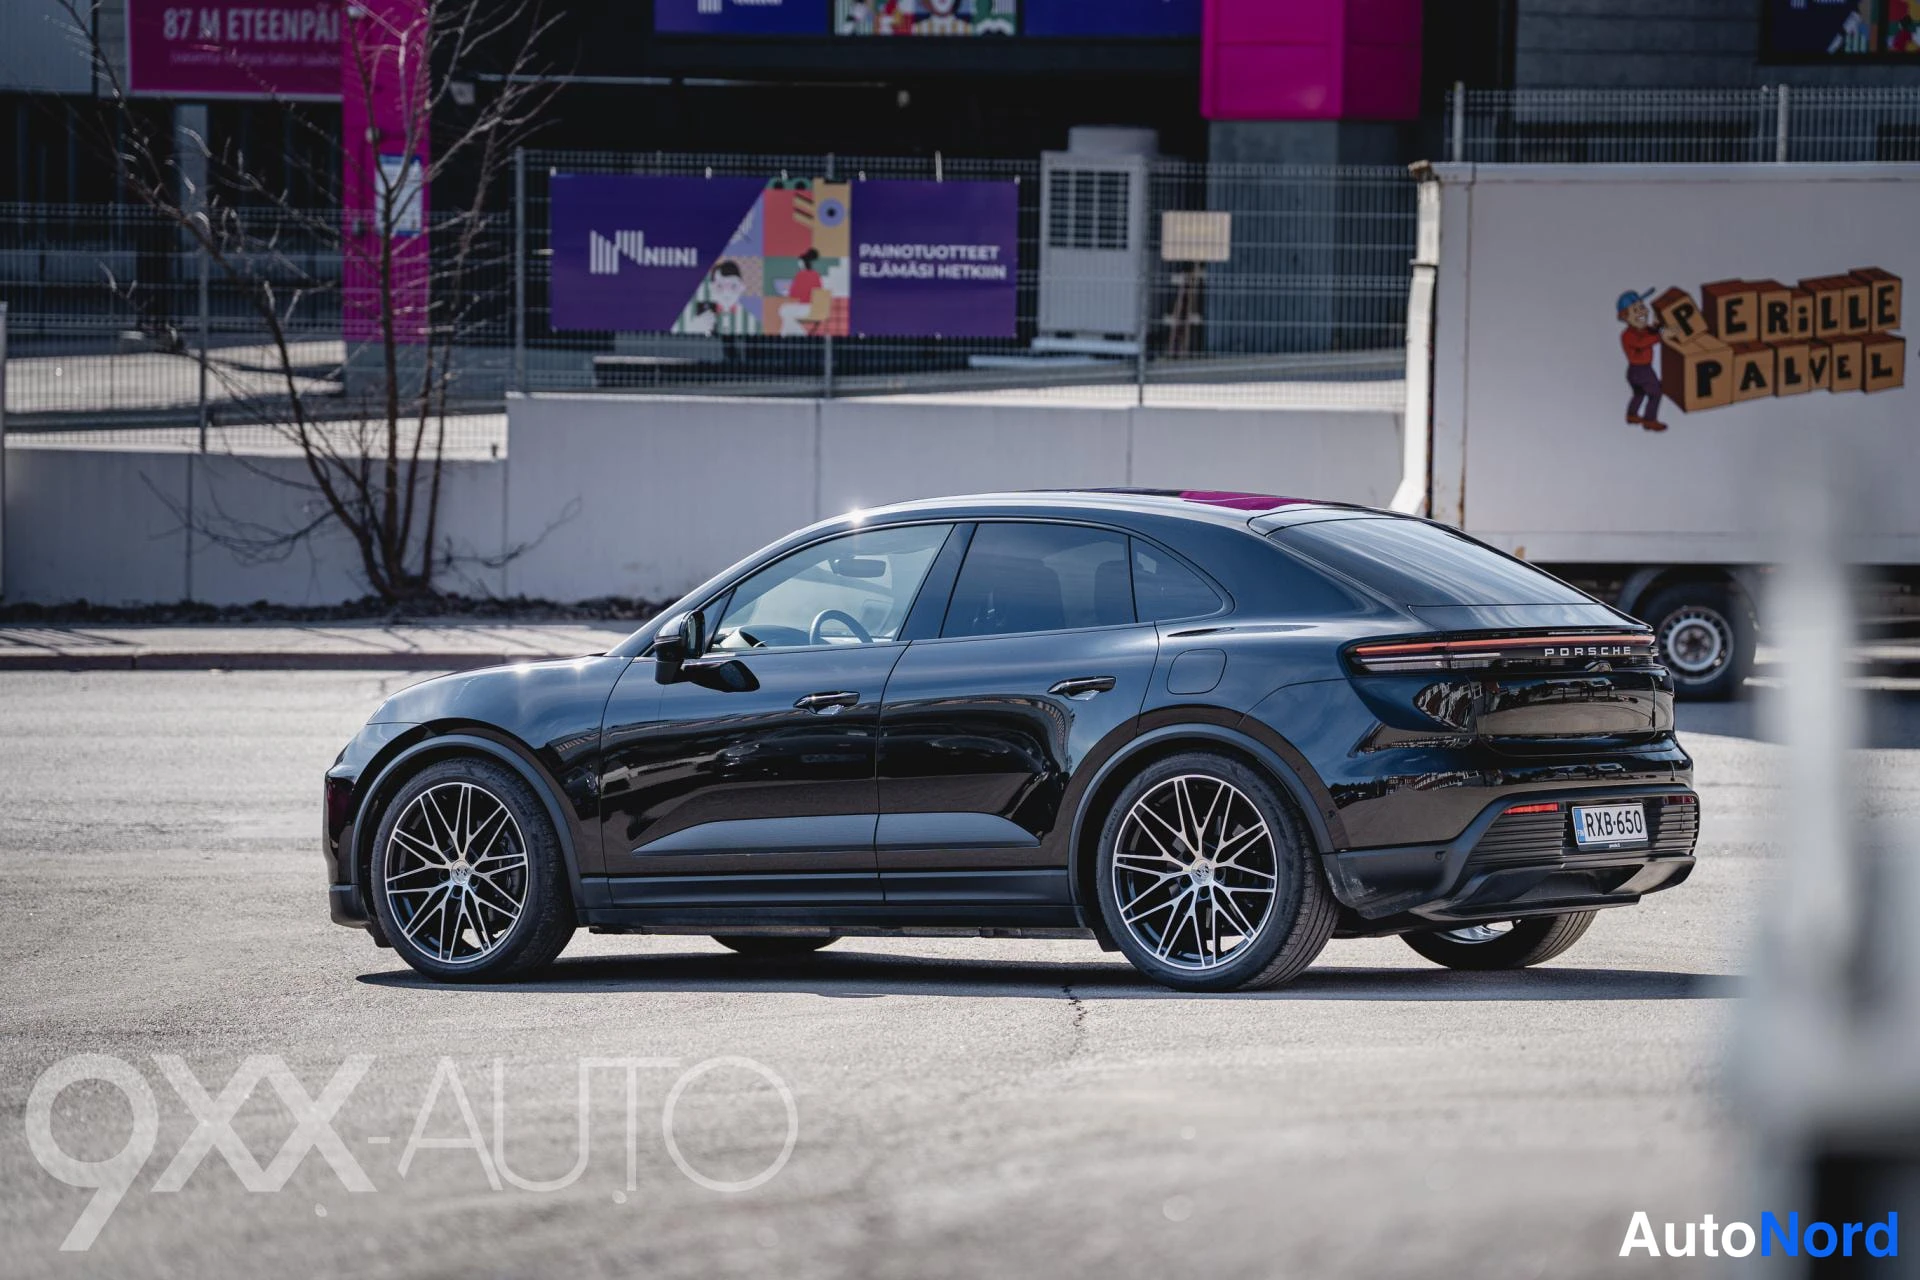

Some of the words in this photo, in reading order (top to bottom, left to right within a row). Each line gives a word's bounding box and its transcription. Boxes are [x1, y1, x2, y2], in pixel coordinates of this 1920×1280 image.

[163, 7, 193, 41] 87
[198, 8, 221, 42] M
[858, 243, 999, 261] PAINOTUOTTEET
[858, 260, 935, 279] ELÄMÄSI
[937, 263, 1007, 280] HETKIIN
[1695, 352, 1894, 398] PALVEL
[1544, 645, 1632, 657] PORSCHE
[1584, 808, 1644, 838] RXB-650
